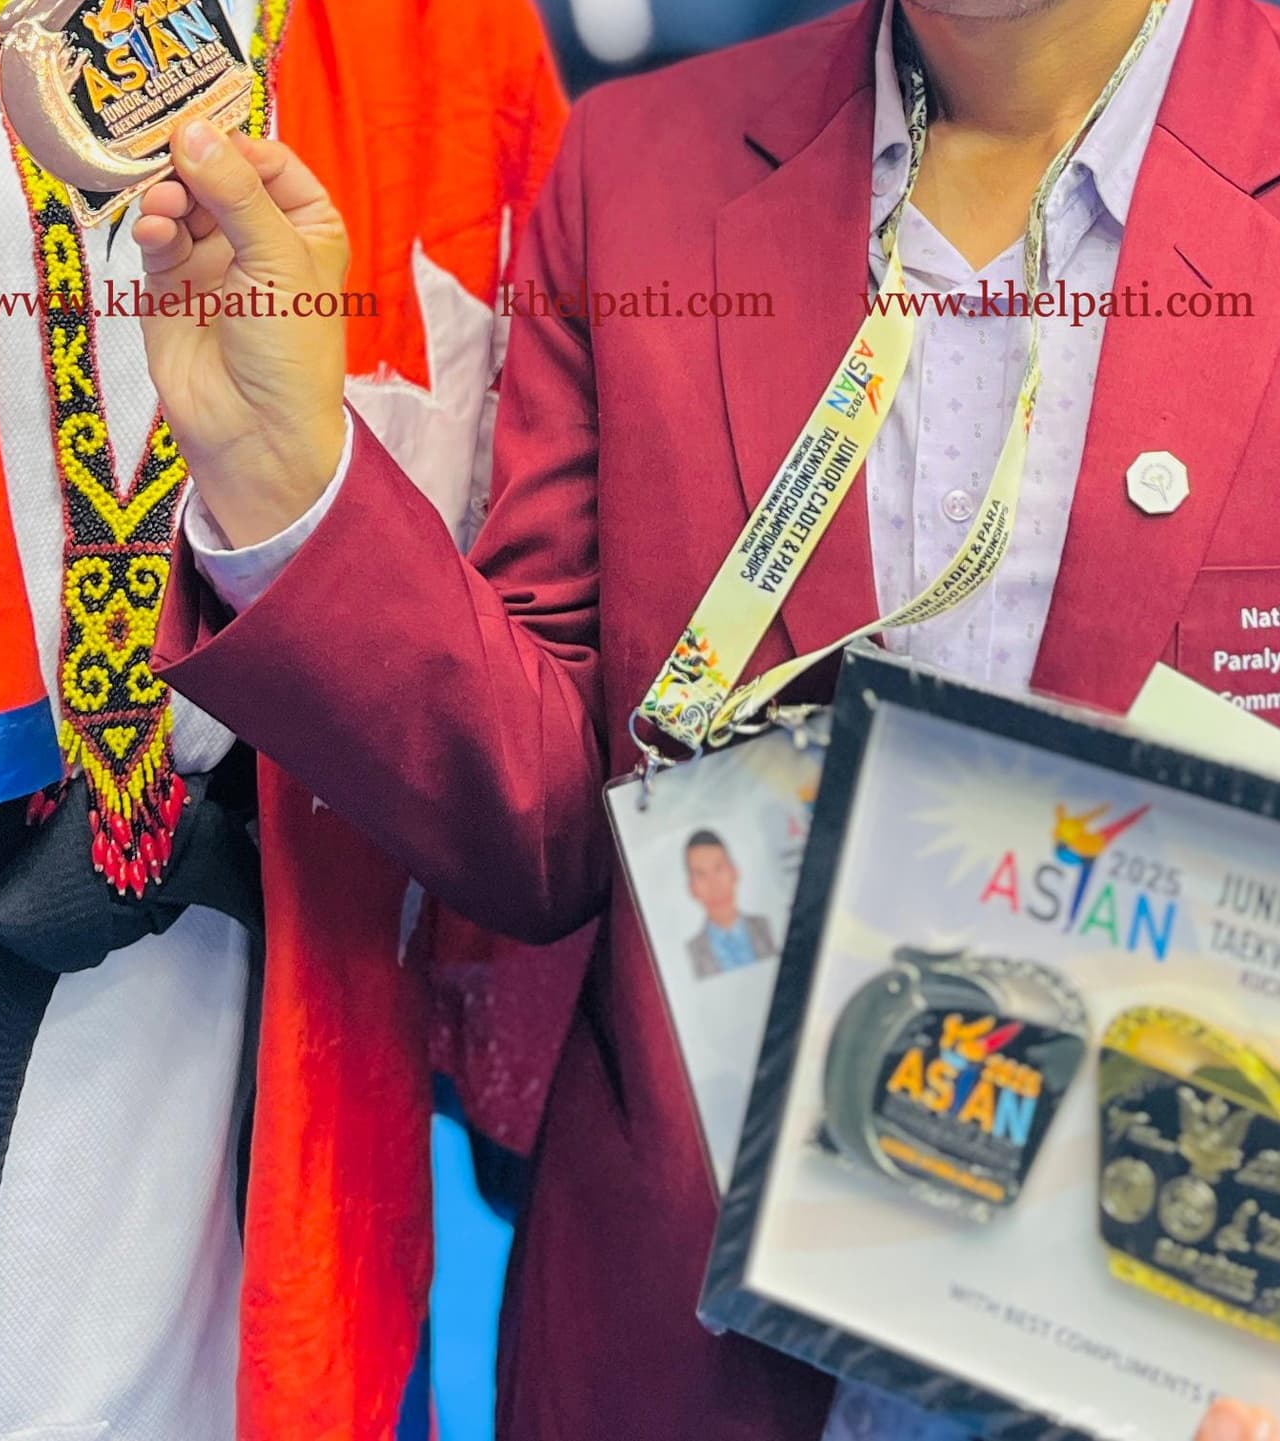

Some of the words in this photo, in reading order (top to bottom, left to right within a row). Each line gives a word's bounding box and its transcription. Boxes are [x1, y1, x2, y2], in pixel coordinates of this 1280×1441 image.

[82, 0, 219, 114] ASIAN
[100, 92, 147, 128] JUNIOR,
[145, 67, 185, 98] CADET
[182, 59, 196, 76] &
[193, 40, 228, 69] PARA
[108, 99, 164, 138] TAEKWONDO
[163, 54, 237, 107] CHAMPIONSHIPS
[826, 339, 875, 414] ASIAN
[846, 391, 866, 421] 2025
[790, 426, 839, 499] TAEKWONDO
[813, 436, 859, 492] JUNIOR,
[740, 495, 799, 582] CHAMPIONSHIPS
[781, 539, 800, 554] &
[790, 491, 829, 543] CADET
[933, 554, 975, 597] CADET
[970, 543, 982, 556] &
[976, 499, 1001, 543] PARA
[957, 505, 1009, 590] CHAMPIONSHIPS
[758, 551, 794, 593] PARA
[979, 849, 1179, 962] ASIAN
[1108, 850, 1184, 897] 2025
[885, 1046, 1039, 1148] ASIAN
